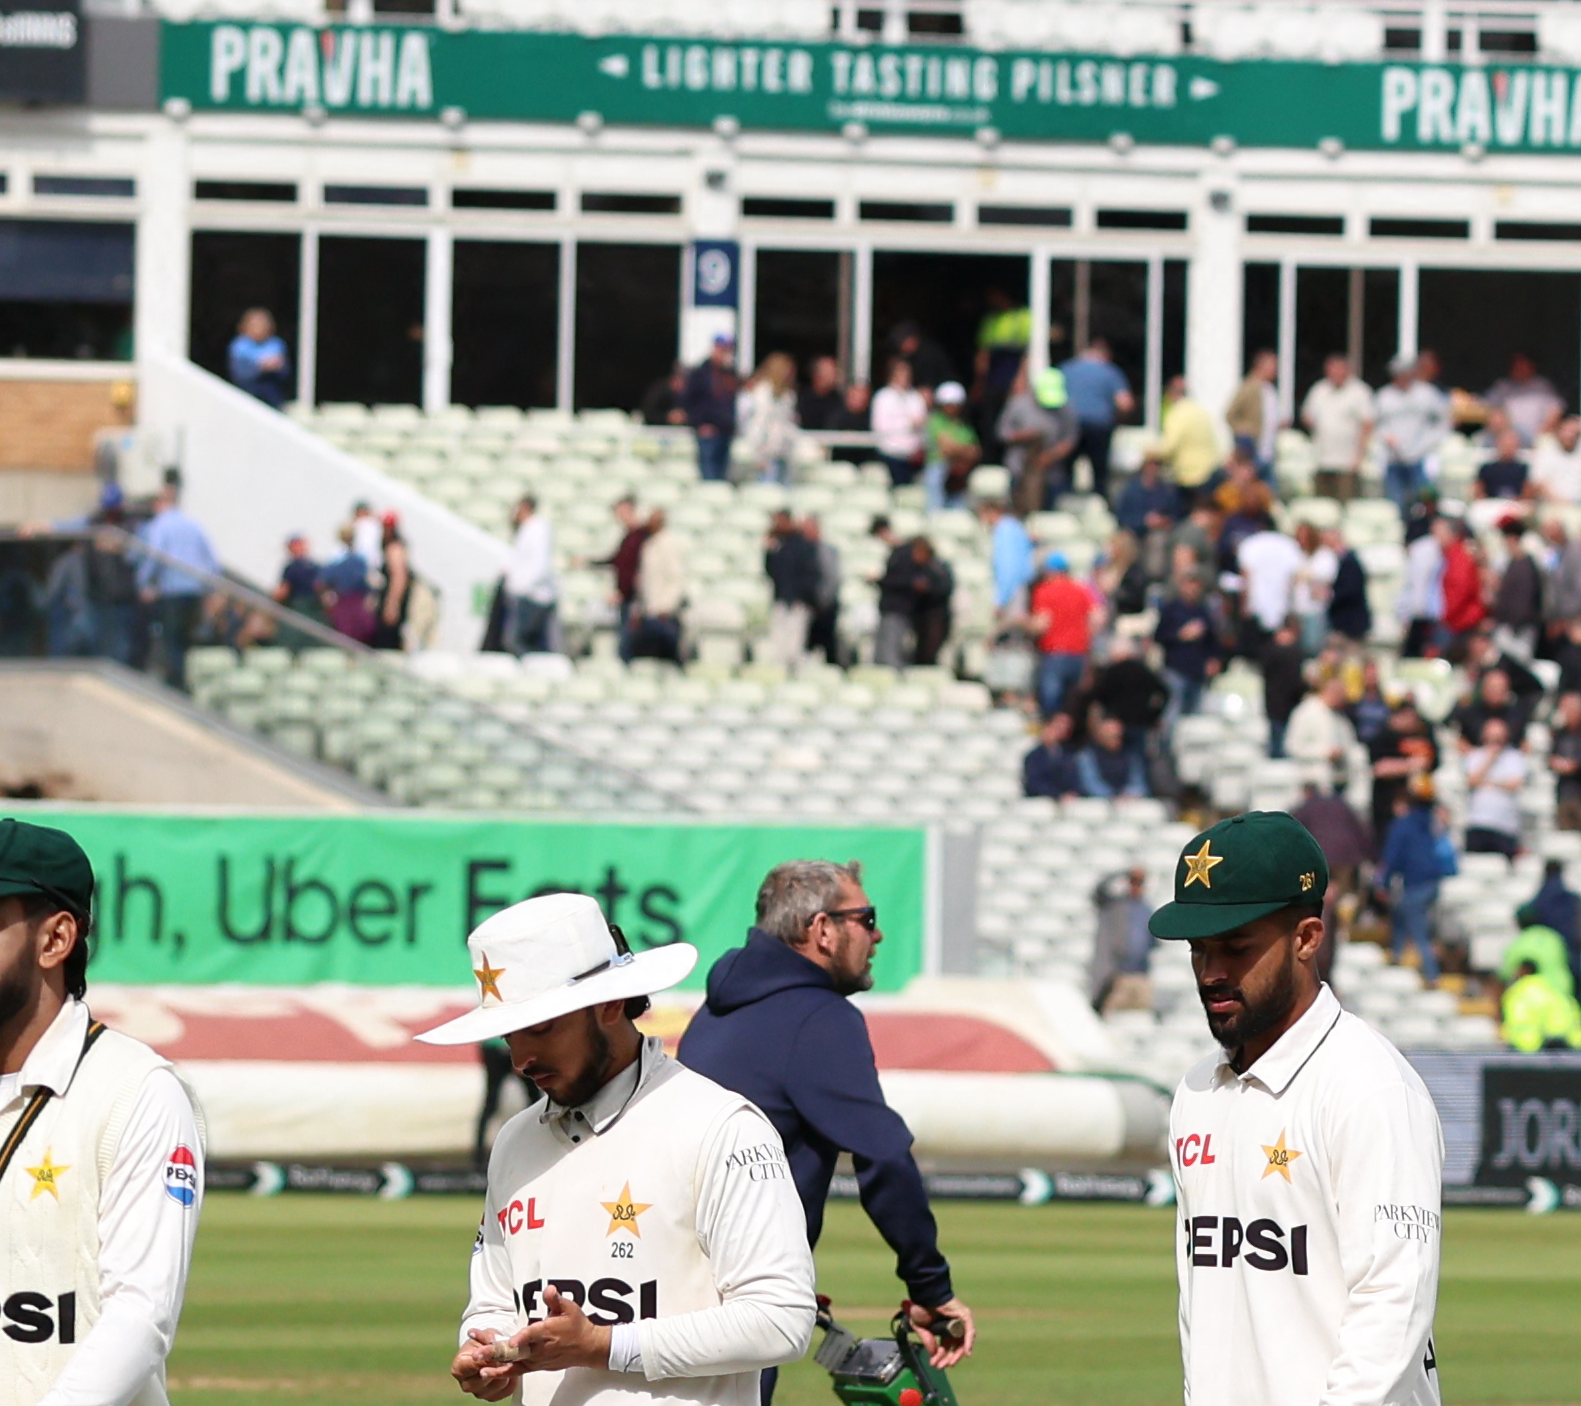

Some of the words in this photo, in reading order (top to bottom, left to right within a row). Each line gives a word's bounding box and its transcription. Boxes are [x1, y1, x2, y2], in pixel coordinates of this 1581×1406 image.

[210, 27, 433, 107] PRAVHA
[641, 45, 814, 94] LIGHTER
[833, 51, 998, 101] TASTING
[1011, 56, 1177, 106] PILSNER
[697, 249, 730, 296] 9
[217, 853, 434, 947] Uber
[465, 858, 684, 948] Ets
[749, 1163, 786, 1182] CITY
[497, 1197, 546, 1241] TCL
[1393, 1222, 1429, 1245] CITY
[611, 1242, 634, 1259] 262
[1184, 1215, 1308, 1276] EPSI
[513, 1277, 658, 1327] EPSI
